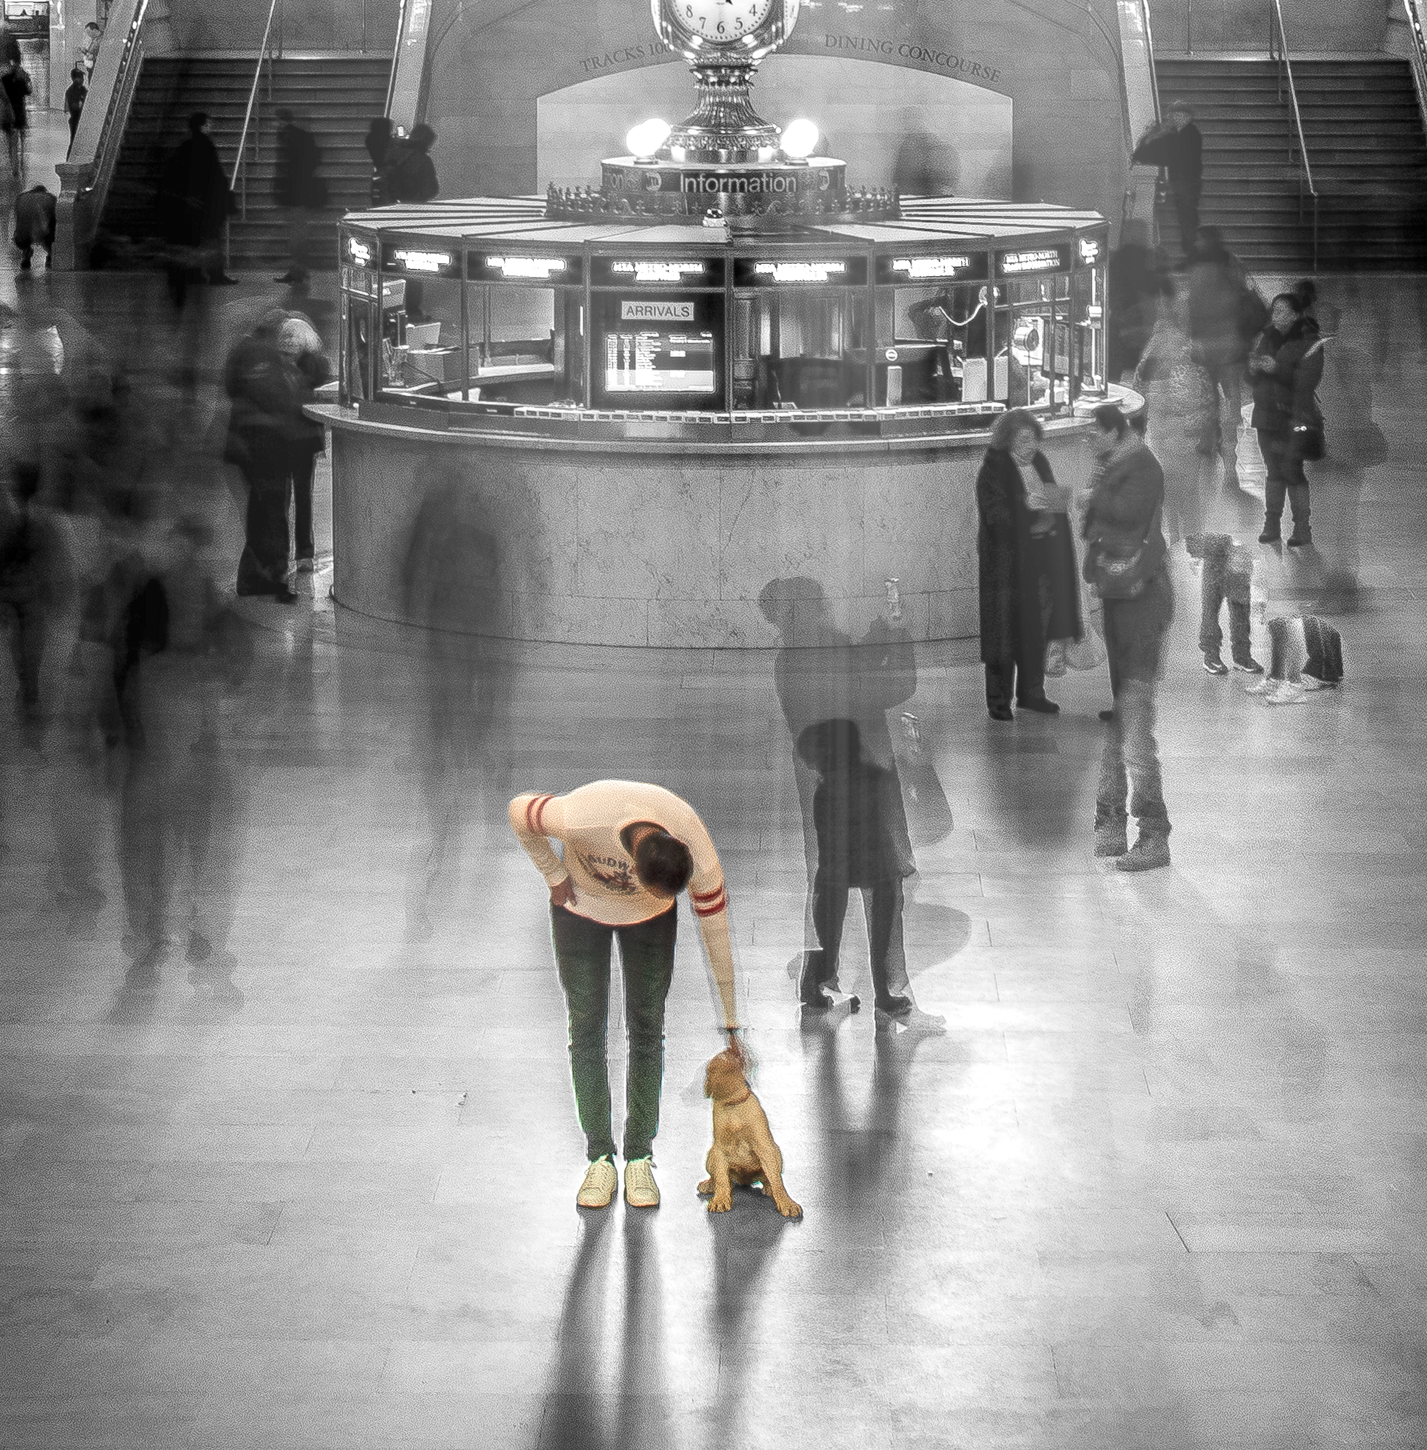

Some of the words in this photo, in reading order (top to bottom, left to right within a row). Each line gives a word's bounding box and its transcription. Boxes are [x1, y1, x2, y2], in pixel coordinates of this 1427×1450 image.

[686, 4, 693, 18] 8
[749, 4, 758, 17] 4
[699, 16, 707, 30] 7
[717, 21, 725, 34] 6
[734, 17, 743, 31] 5
[579, 45, 645, 71] TRACKS
[824, 33, 893, 55] DINING
[898, 43, 1002, 83] CONCOURSE
[680, 172, 797, 193] Information
[626, 305, 690, 318] ARRIVALS
